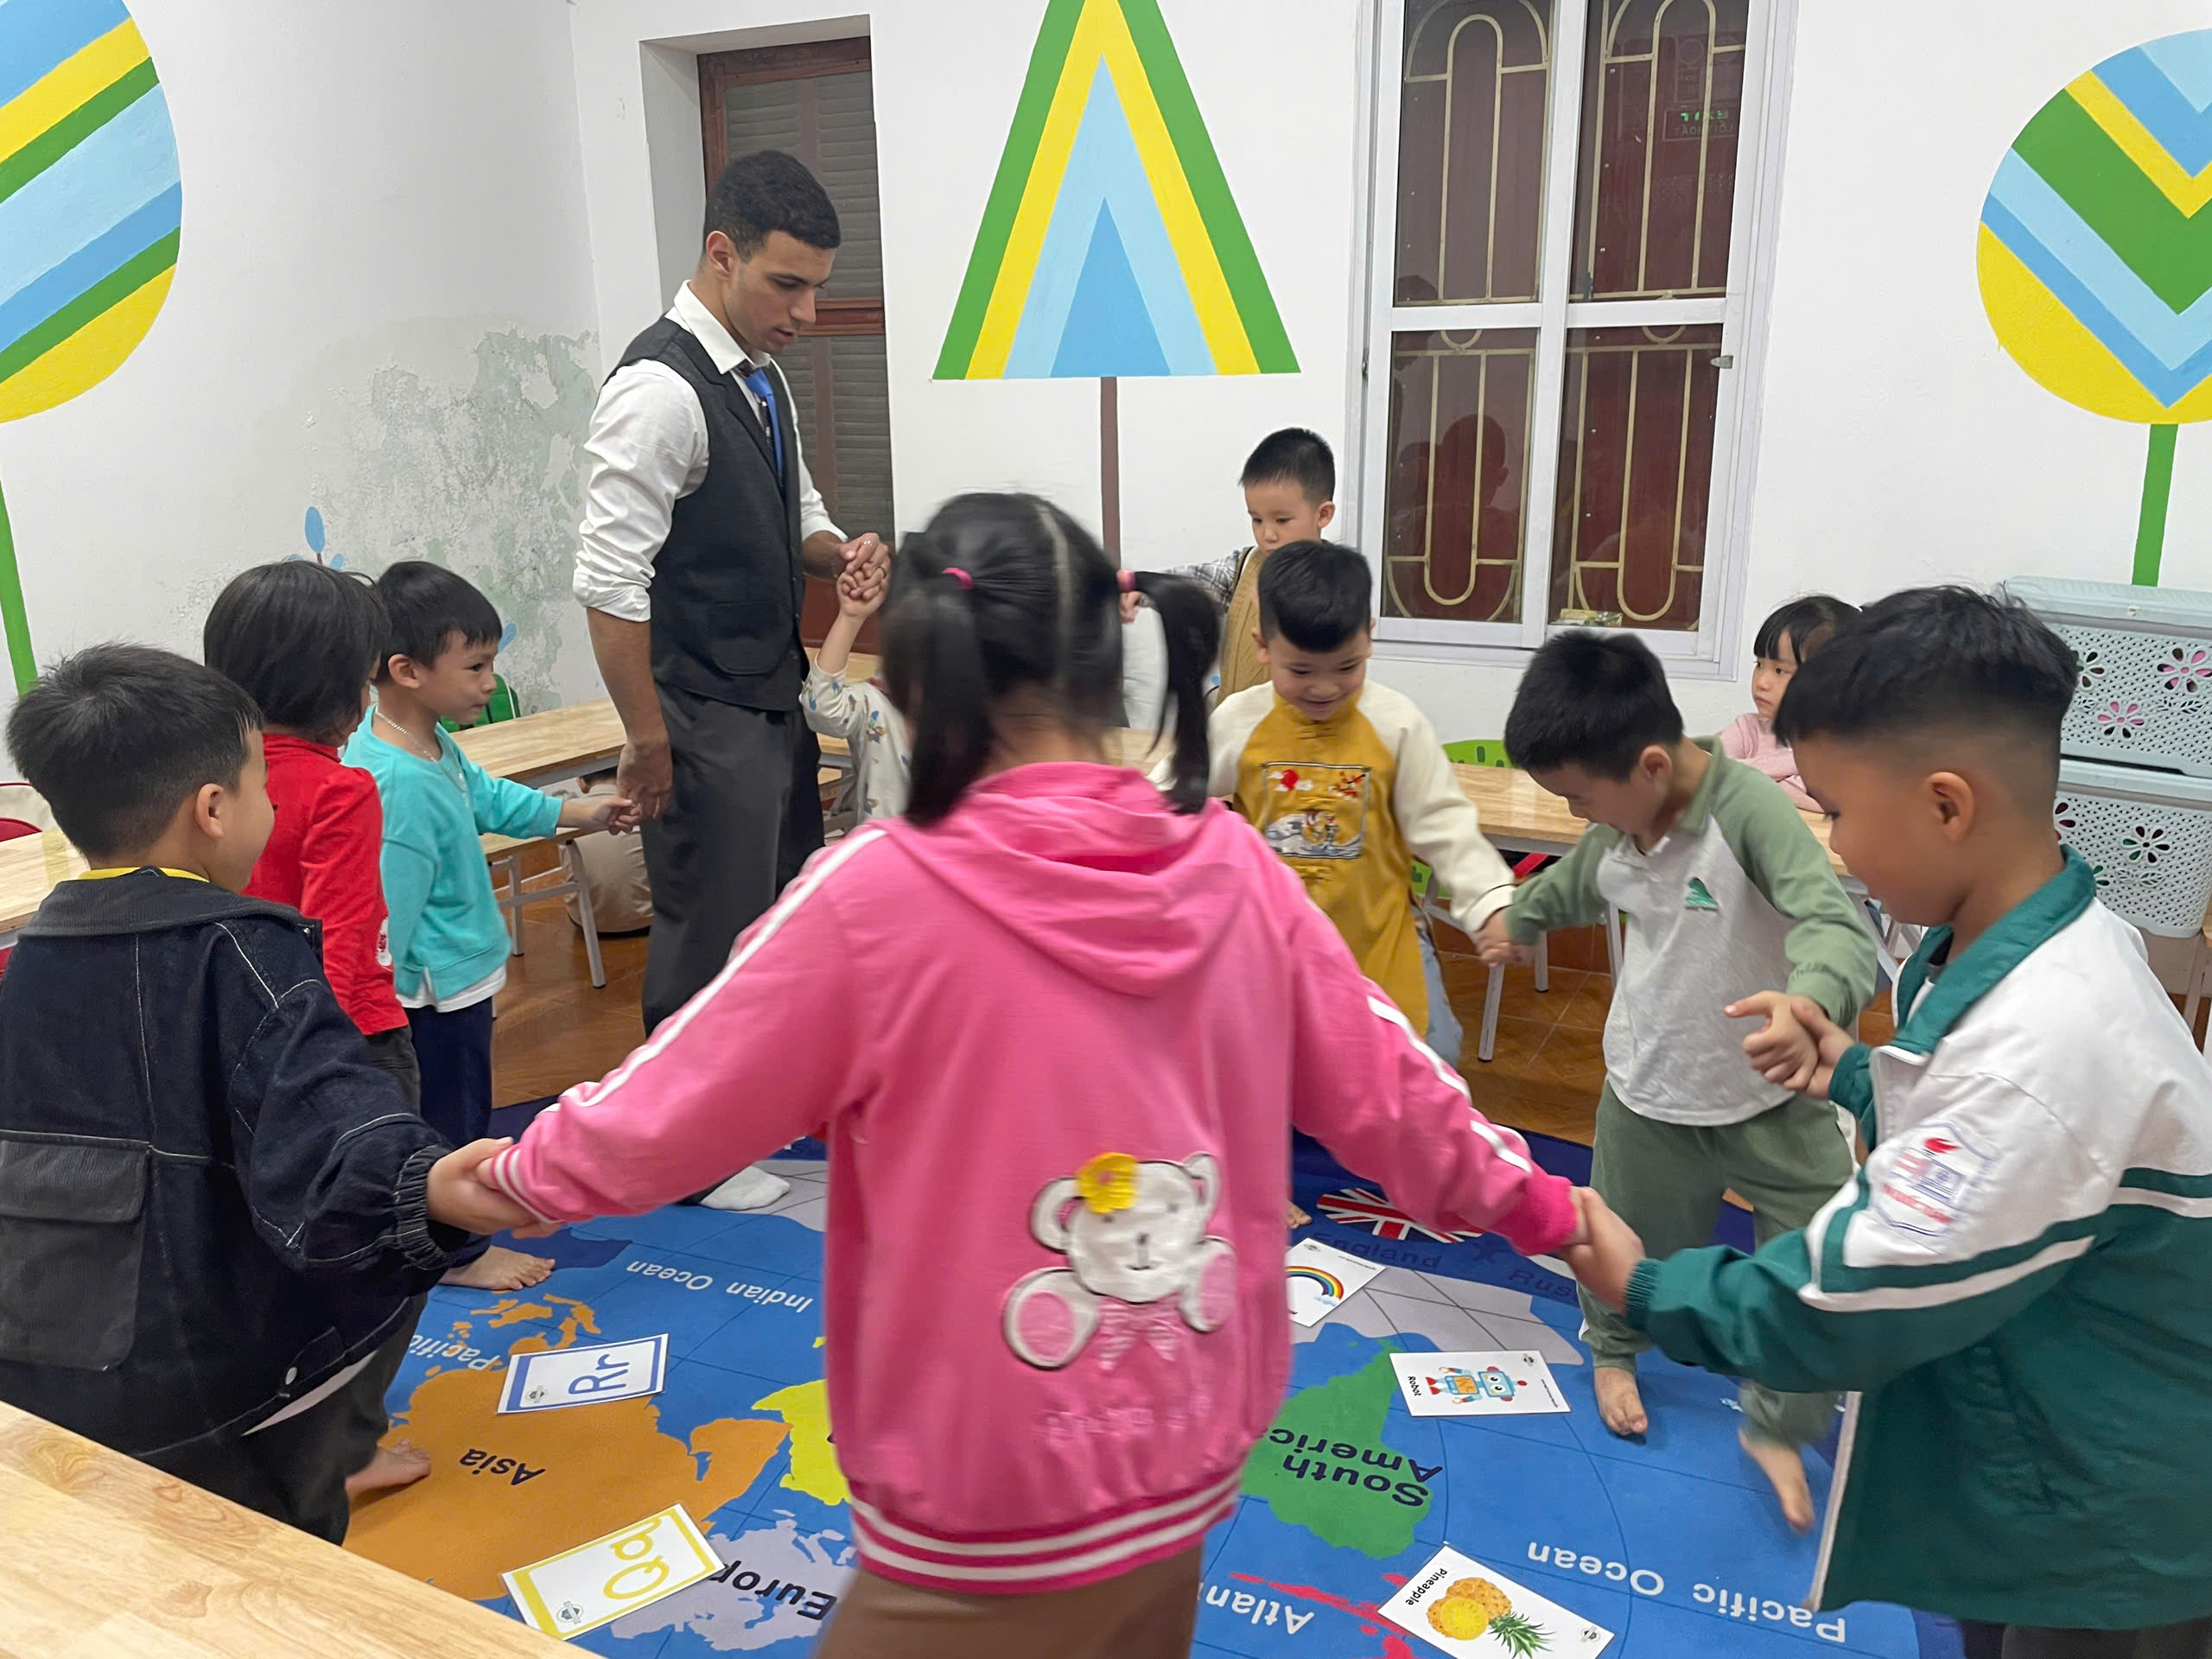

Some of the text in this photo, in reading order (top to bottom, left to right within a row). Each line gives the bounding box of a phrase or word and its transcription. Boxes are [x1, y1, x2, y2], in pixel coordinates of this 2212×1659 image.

[626, 1261, 813, 1313] Indian Ocean
[1509, 1269, 1572, 1295] Rus
[569, 1354, 630, 1394] Rr
[1408, 1376, 1422, 1396] Robot
[460, 1448, 546, 1485] Asia
[1268, 1428, 1443, 1482] Americ
[1283, 1455, 1428, 1506] South
[602, 1519, 670, 1599] Qq
[709, 1560, 837, 1620] Europ
[1198, 1583, 1314, 1634] Atlan
[1405, 1567, 1448, 1605] Pineapple
[1528, 1542, 1846, 1642] Pacific Ocean
